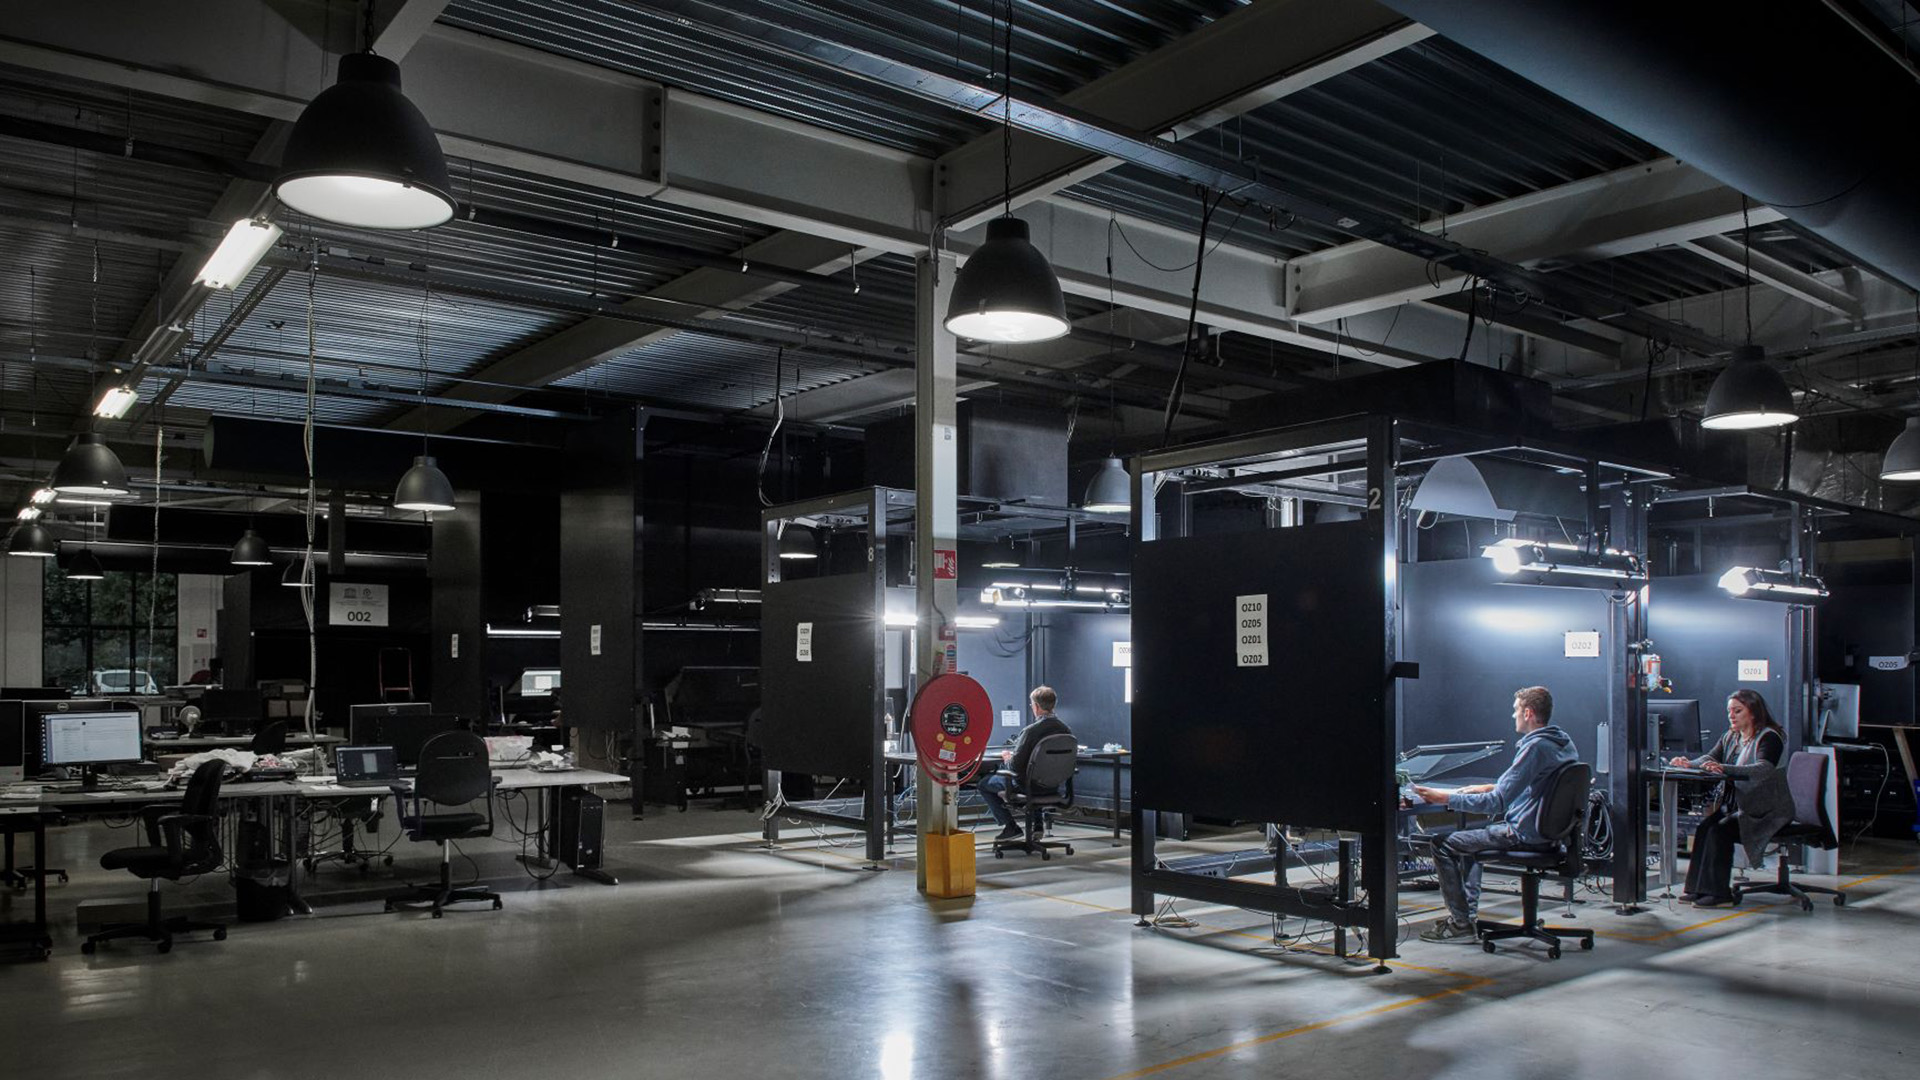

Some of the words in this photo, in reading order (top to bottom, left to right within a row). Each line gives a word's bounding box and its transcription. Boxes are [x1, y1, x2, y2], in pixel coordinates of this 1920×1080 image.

[1368, 487, 1381, 510] 2
[868, 547, 874, 562] 8
[347, 611, 371, 622] 002
